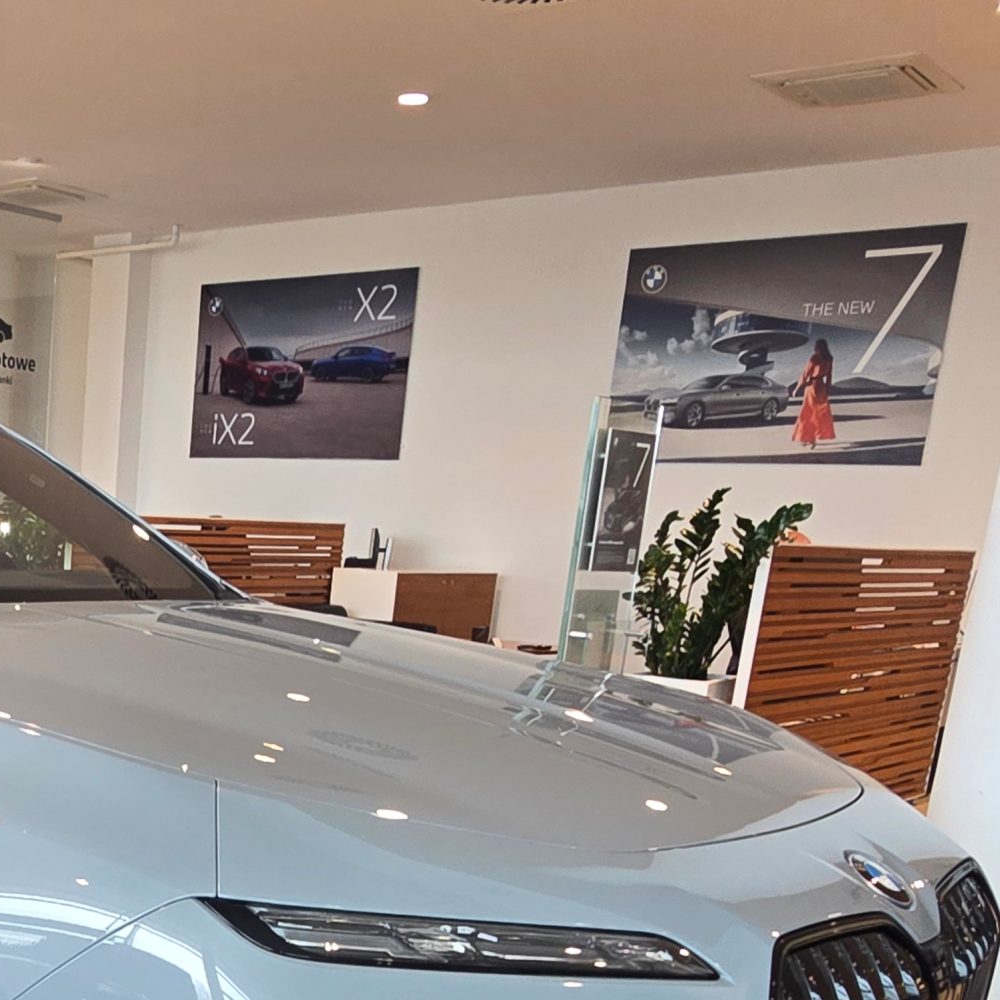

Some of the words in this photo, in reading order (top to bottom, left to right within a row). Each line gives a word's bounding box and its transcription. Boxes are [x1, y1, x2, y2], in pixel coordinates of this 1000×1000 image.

[353, 284, 398, 323] X2
[803, 302, 835, 317] THE
[837, 300, 876, 315] NEW
[852, 244, 944, 375] 7
[212, 413, 255, 445] iX2
[632, 442, 651, 488] 7
